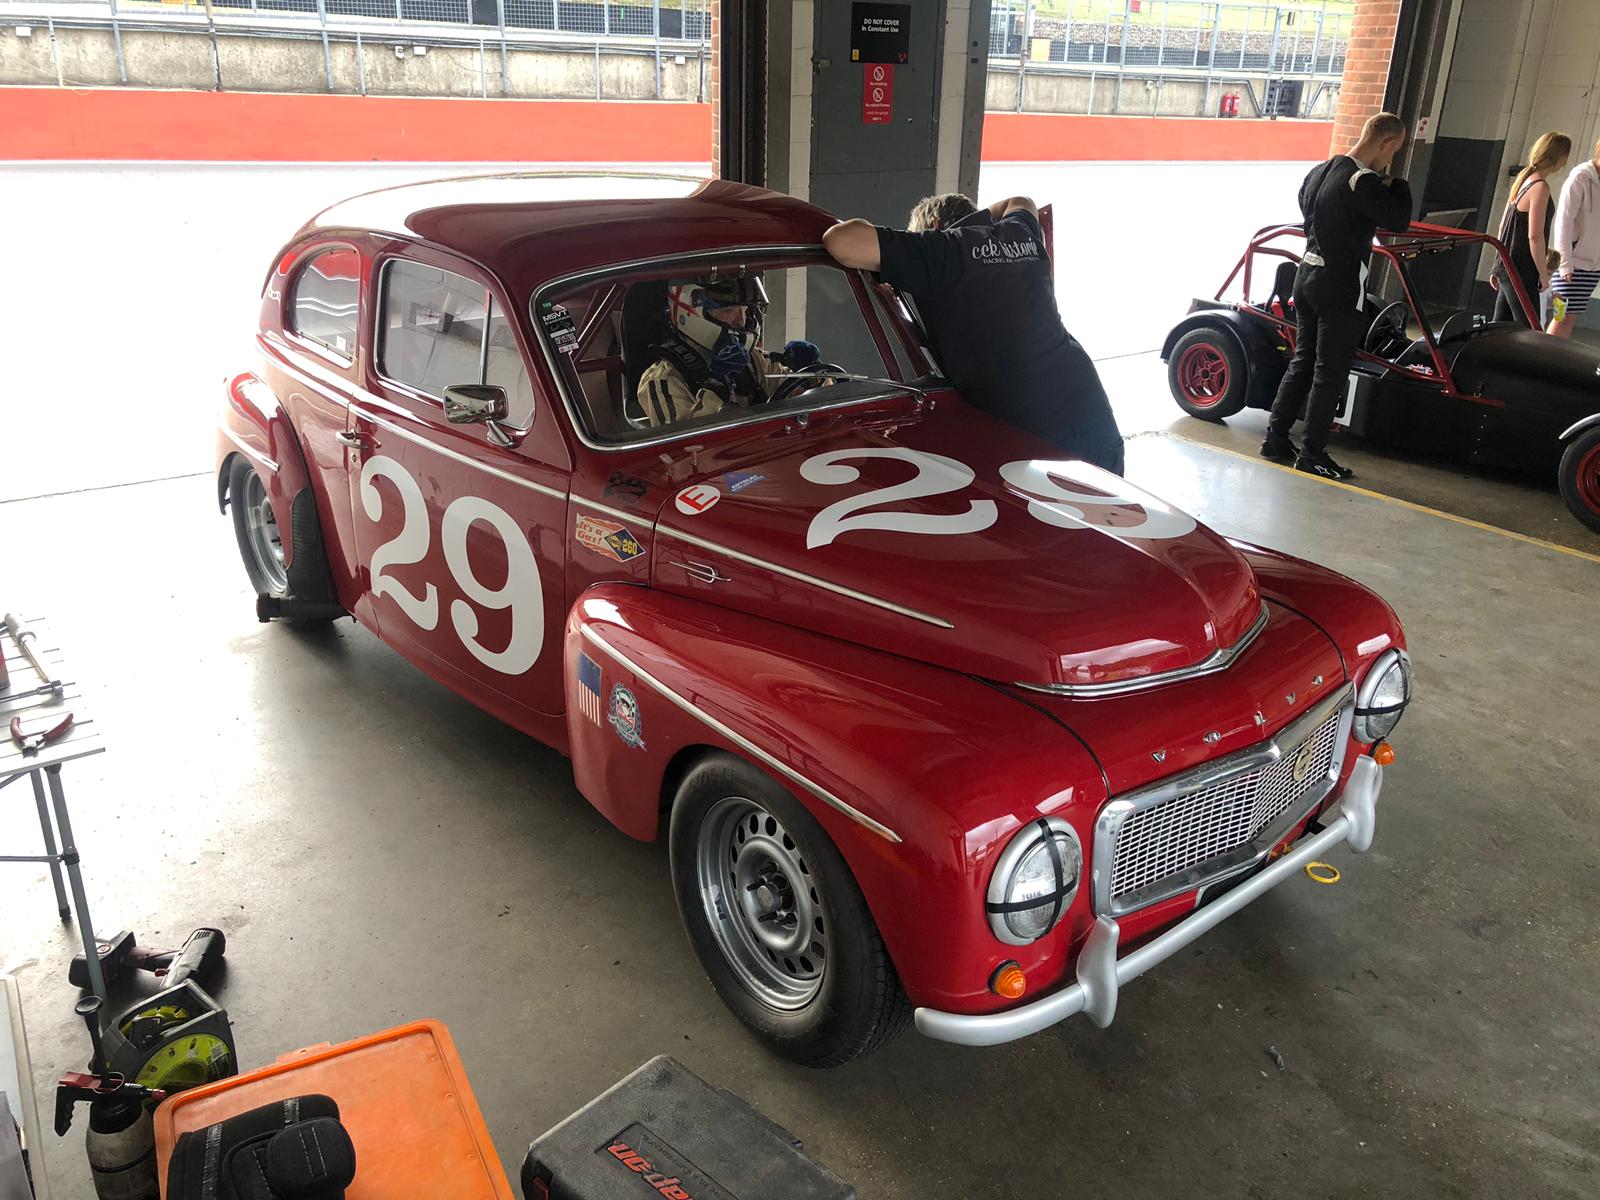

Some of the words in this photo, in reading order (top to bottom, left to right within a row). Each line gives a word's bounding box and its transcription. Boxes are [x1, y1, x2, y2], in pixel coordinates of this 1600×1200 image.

[972, 238, 1000, 259] cck
[542, 309, 567, 322] MSVT
[678, 486, 718, 512] E
[799, 447, 1197, 550] 29
[577, 530, 602, 545] Gas!
[578, 521, 593, 532] It's
[595, 528, 602, 536] a
[622, 539, 638, 556] 260
[360, 455, 545, 675] 29
